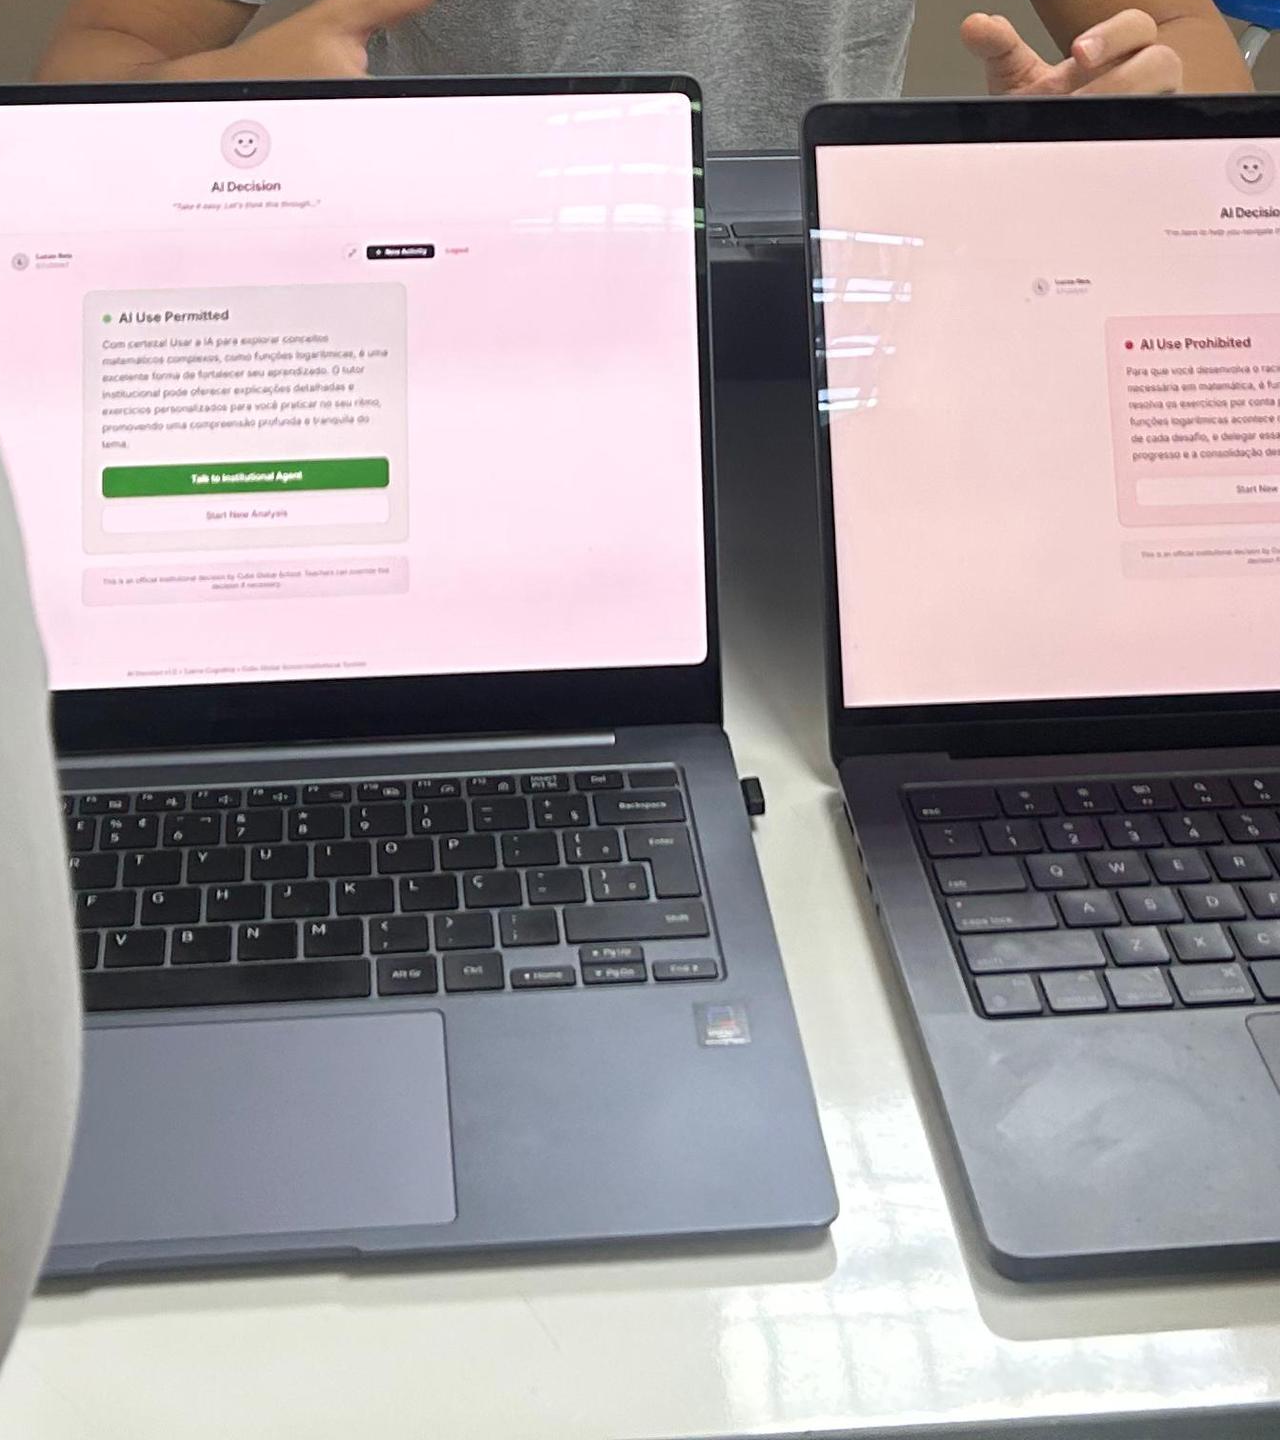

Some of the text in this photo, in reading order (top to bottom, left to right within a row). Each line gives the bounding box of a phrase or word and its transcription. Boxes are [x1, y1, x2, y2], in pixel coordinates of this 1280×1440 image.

[211, 180, 281, 192] AI Decision
[1220, 207, 1233, 218] AI
[119, 310, 229, 323] AI Use Permitted
[1140, 336, 1251, 350] AI Use Prohibited
[191, 470, 303, 484] Talk to Institutional Agent
[1236, 484, 1257, 494] Start
[1259, 484, 1278, 493] New
[206, 509, 288, 520] Start New Analysis
[385, 841, 398, 854] O
[448, 838, 459, 850] P
[135, 854, 144, 865] T
[198, 852, 208, 862] Y
[260, 849, 272, 860] U
[1049, 864, 1064, 878] Q
[1108, 861, 1125, 874] W
[409, 879, 419, 891] L
[472, 875, 483, 889] Ç
[216, 889, 228, 900] H
[283, 886, 292, 897] J
[344, 883, 357, 894] K
[152, 892, 164, 904] G
[1205, 895, 1219, 908] D
[1083, 902, 1096, 914] A
[247, 927, 260, 939] N
[311, 924, 326, 936] M
[115, 934, 127, 946] V
[181, 931, 193, 942] B
[1257, 932, 1270, 944] C
